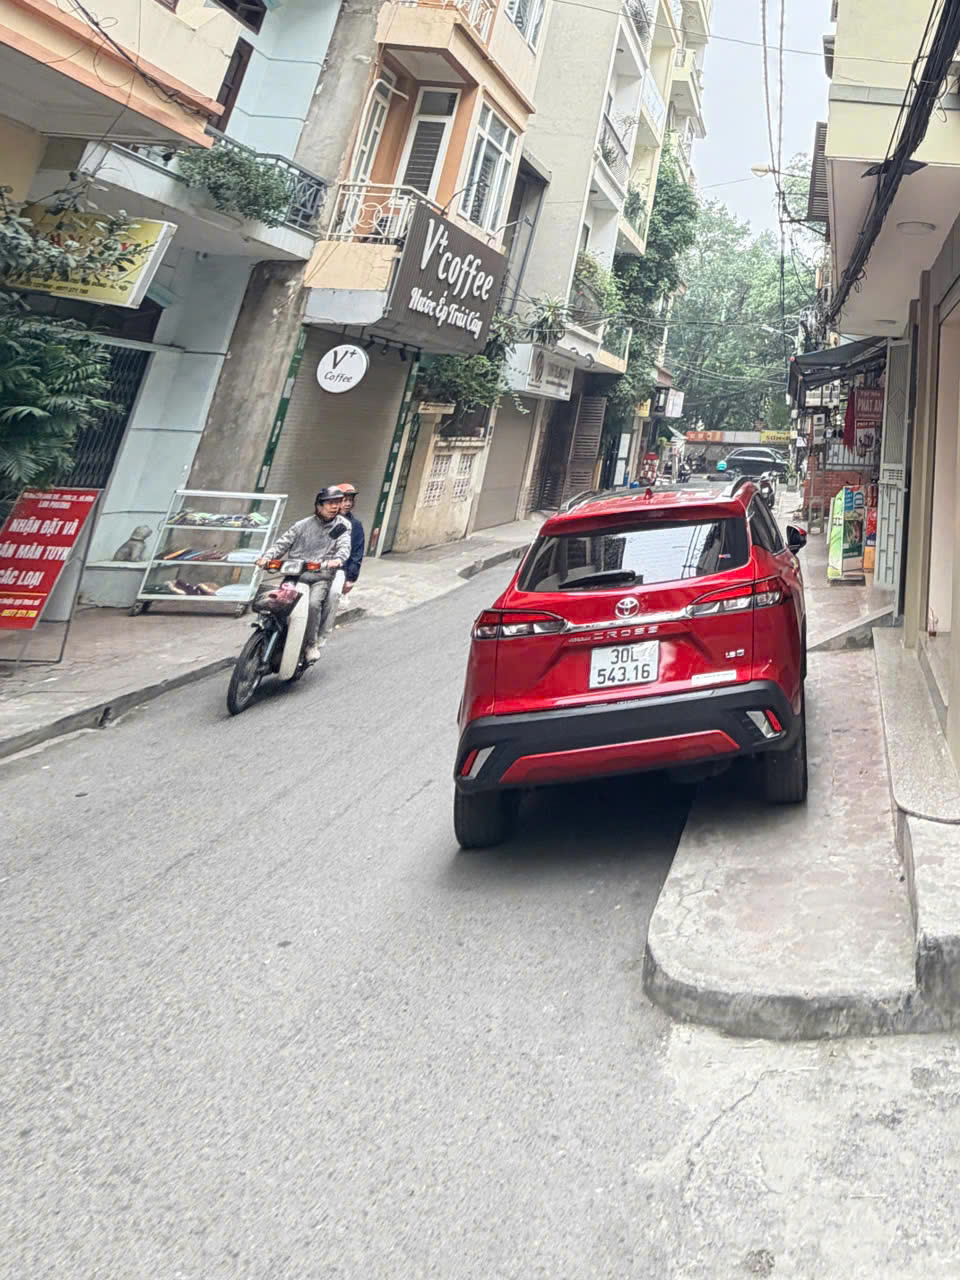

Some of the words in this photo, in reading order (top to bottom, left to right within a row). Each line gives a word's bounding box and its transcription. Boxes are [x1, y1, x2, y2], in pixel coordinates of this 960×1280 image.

[437, 251, 494, 300] coffee
[324, 371, 353, 383] Coffee
[8, 516, 41, 535] NHẬN
[0, 540, 17, 558] ÁN
[16, 570, 45, 588] LOẠI
[593, 625, 659, 641] CROSS
[610, 646, 639, 665] 30L
[597, 663, 651, 685] 543.16
